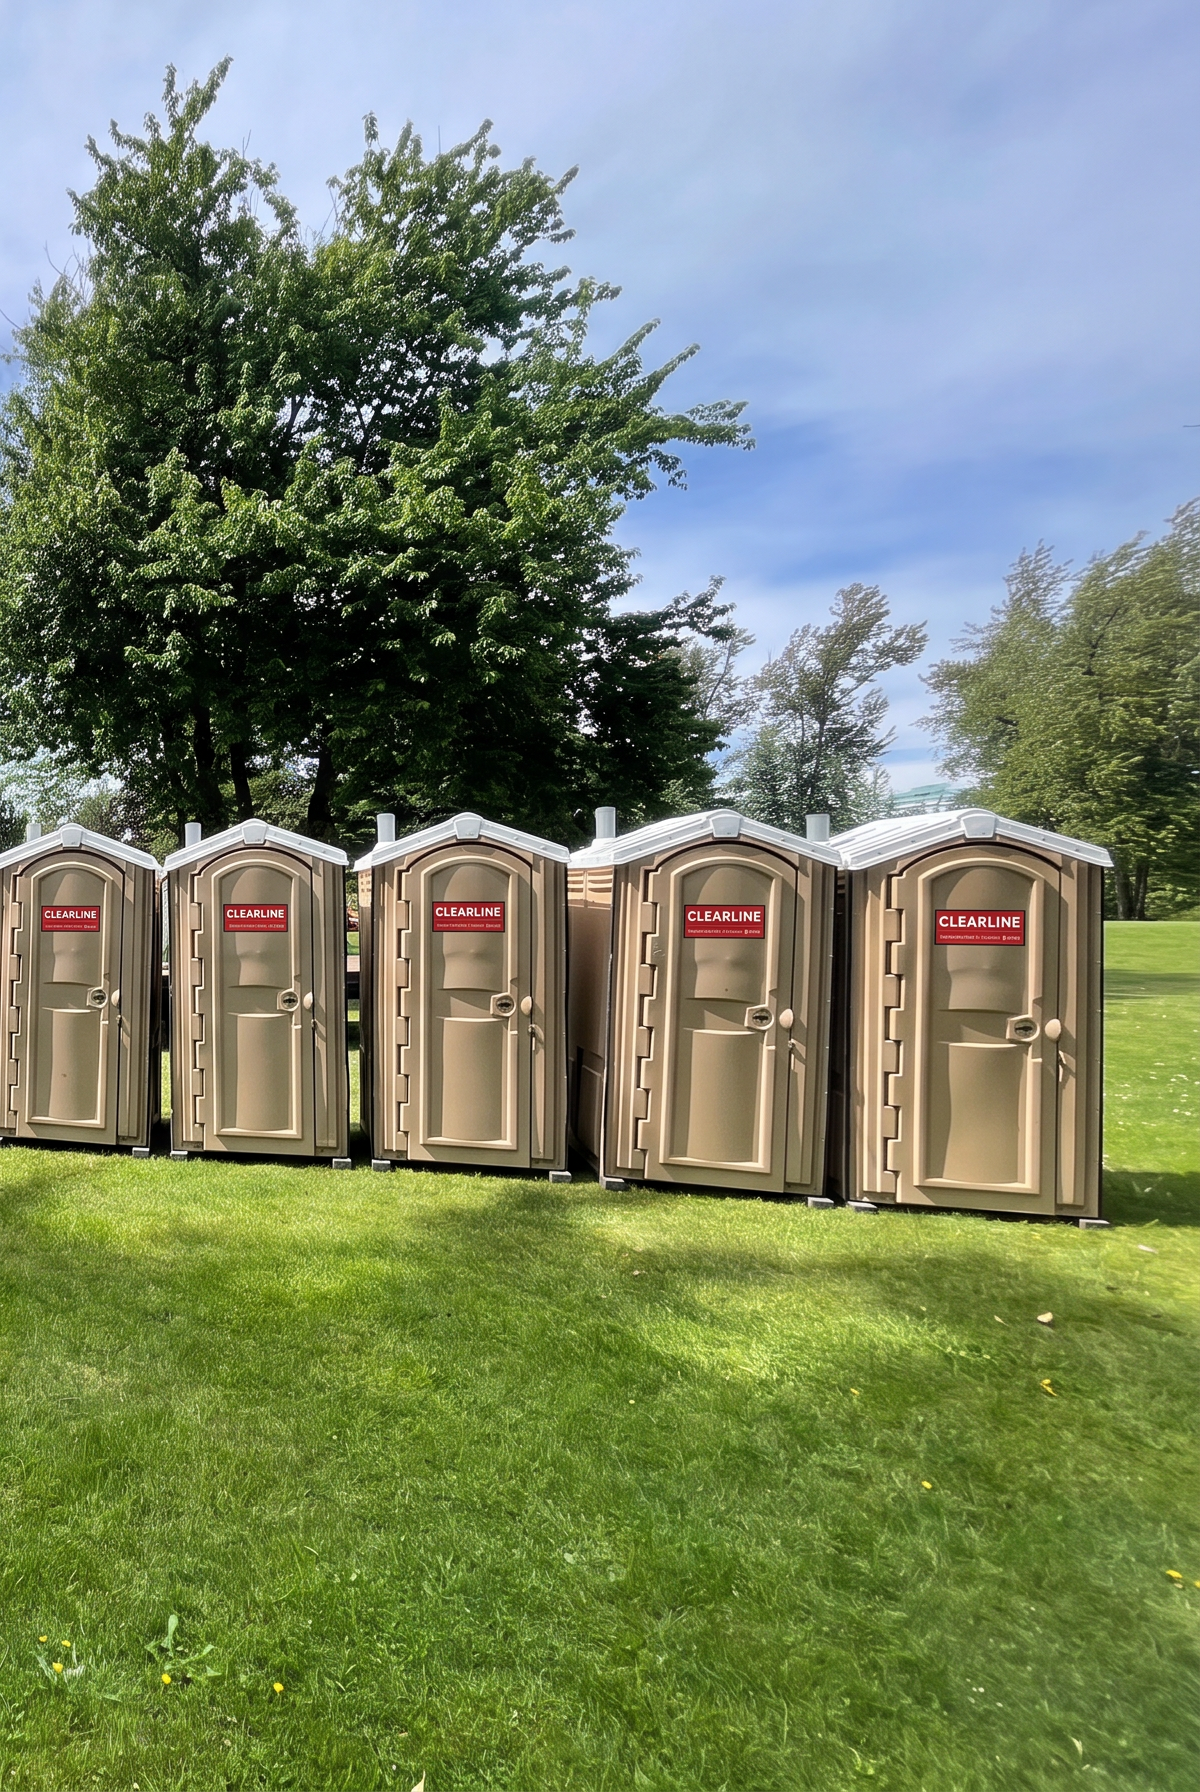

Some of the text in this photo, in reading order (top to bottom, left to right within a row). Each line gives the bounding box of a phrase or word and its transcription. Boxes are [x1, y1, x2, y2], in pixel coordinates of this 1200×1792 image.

[44, 910, 97, 919] CLEARLINE
[226, 909, 285, 919] CLEARLINE
[435, 906, 501, 917] CLEARLINE
[687, 910, 762, 922] CLEARLINE
[938, 915, 1021, 929] CLEARLINE
